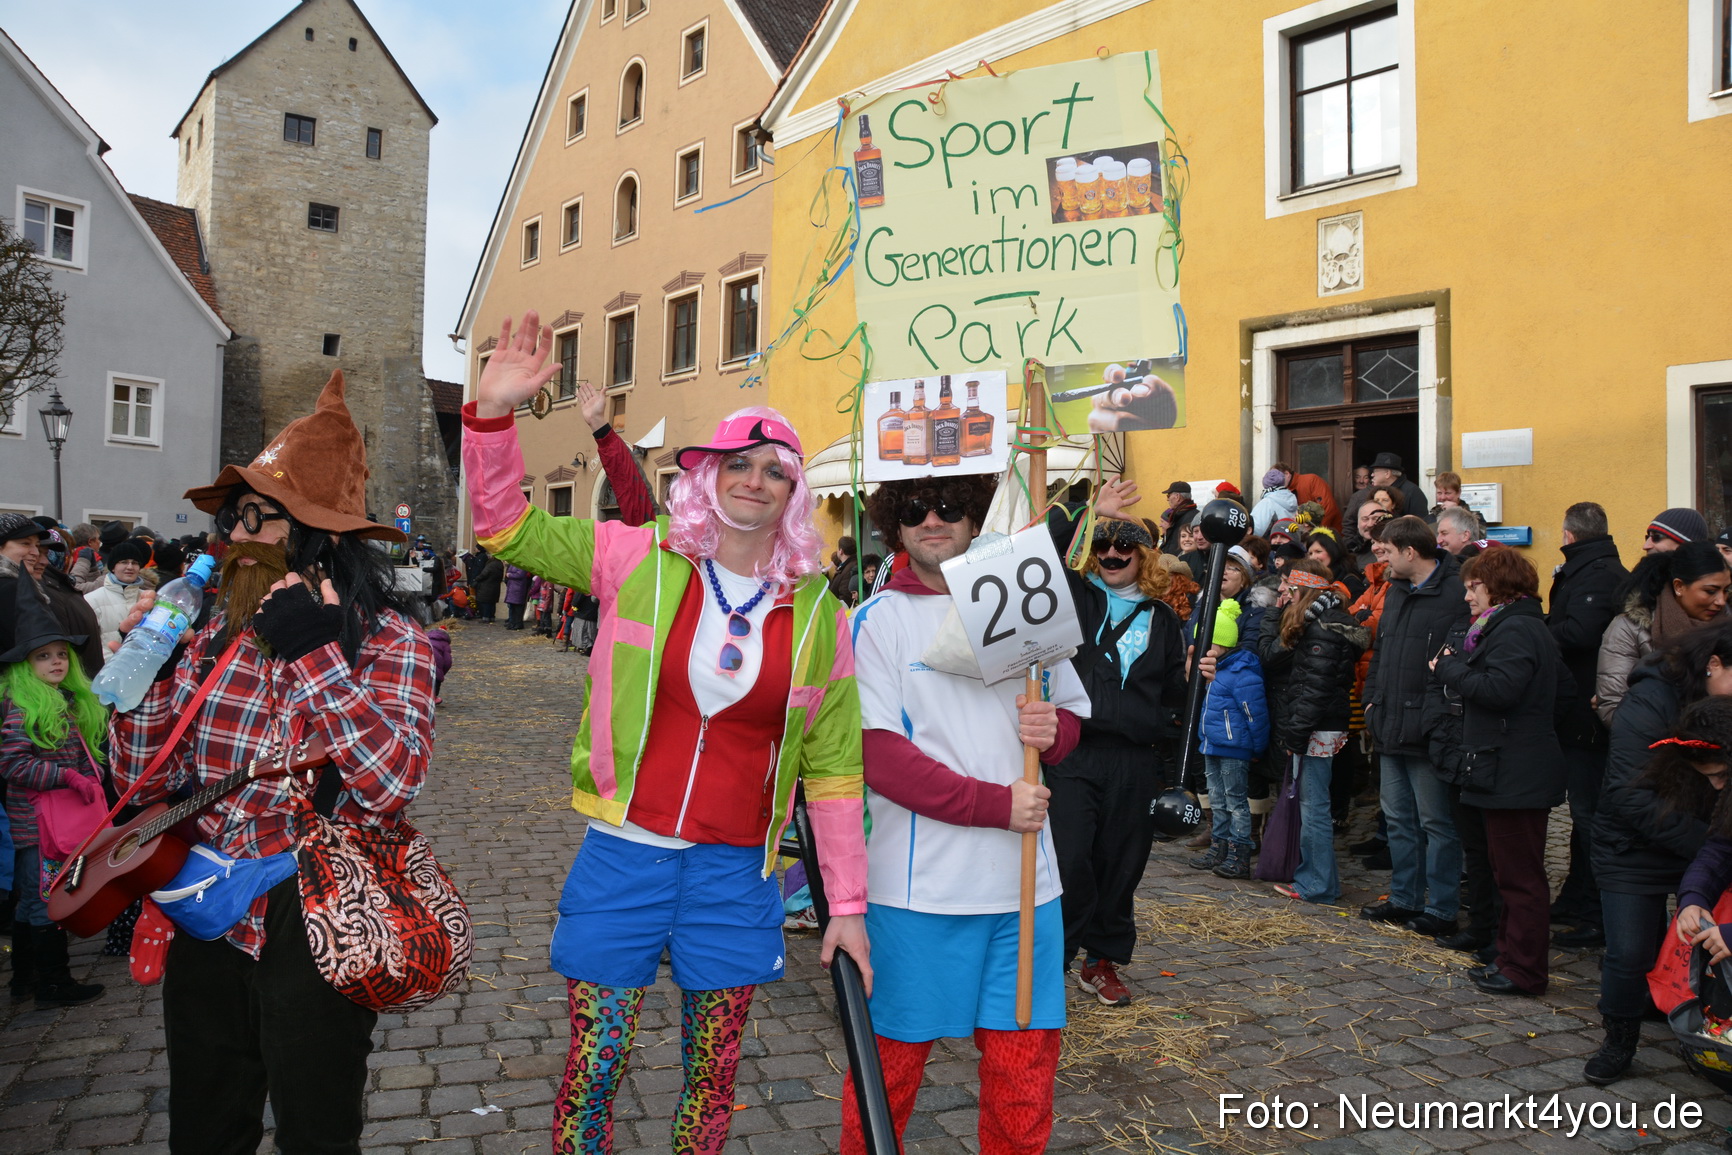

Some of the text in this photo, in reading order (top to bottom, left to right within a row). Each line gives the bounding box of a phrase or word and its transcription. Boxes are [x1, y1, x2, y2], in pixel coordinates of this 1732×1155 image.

[888, 82, 1094, 188] Sport
[970, 180, 1038, 215] im
[864, 215, 1137, 288] Generationen
[908, 296, 1084, 370] Park
[1228, 508, 1239, 527] 250
[1238, 512, 1247, 529] KG
[970, 556, 1058, 647] 28
[1182, 804, 1194, 824] 250
[1191, 808, 1201, 825] KG
